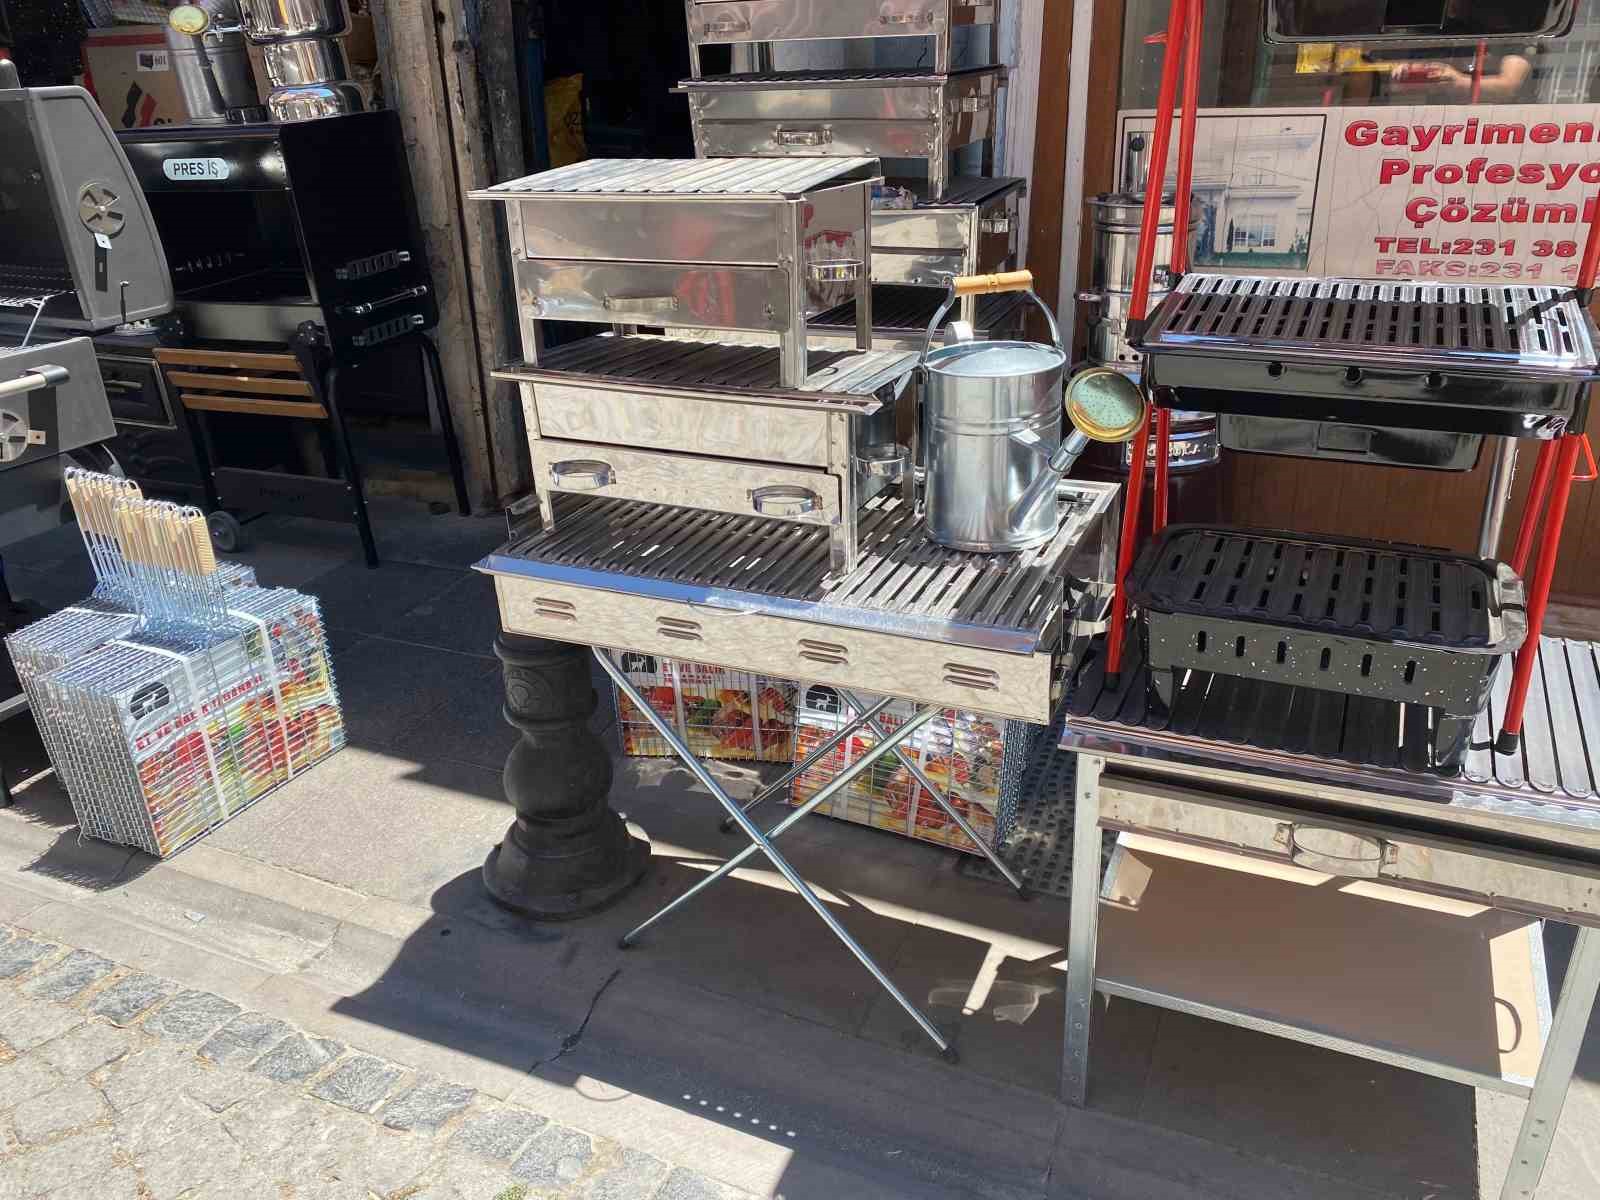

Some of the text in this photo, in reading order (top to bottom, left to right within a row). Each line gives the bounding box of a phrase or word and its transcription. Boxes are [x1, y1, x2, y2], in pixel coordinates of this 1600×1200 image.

[1344, 117, 1600, 152] Gayrimen
[173, 162, 205, 176] PRES
[1379, 157, 1600, 190] Profesyo
[1374, 237, 1577, 258] TEL:231 38
[1375, 259, 1543, 279] FAKS:231
